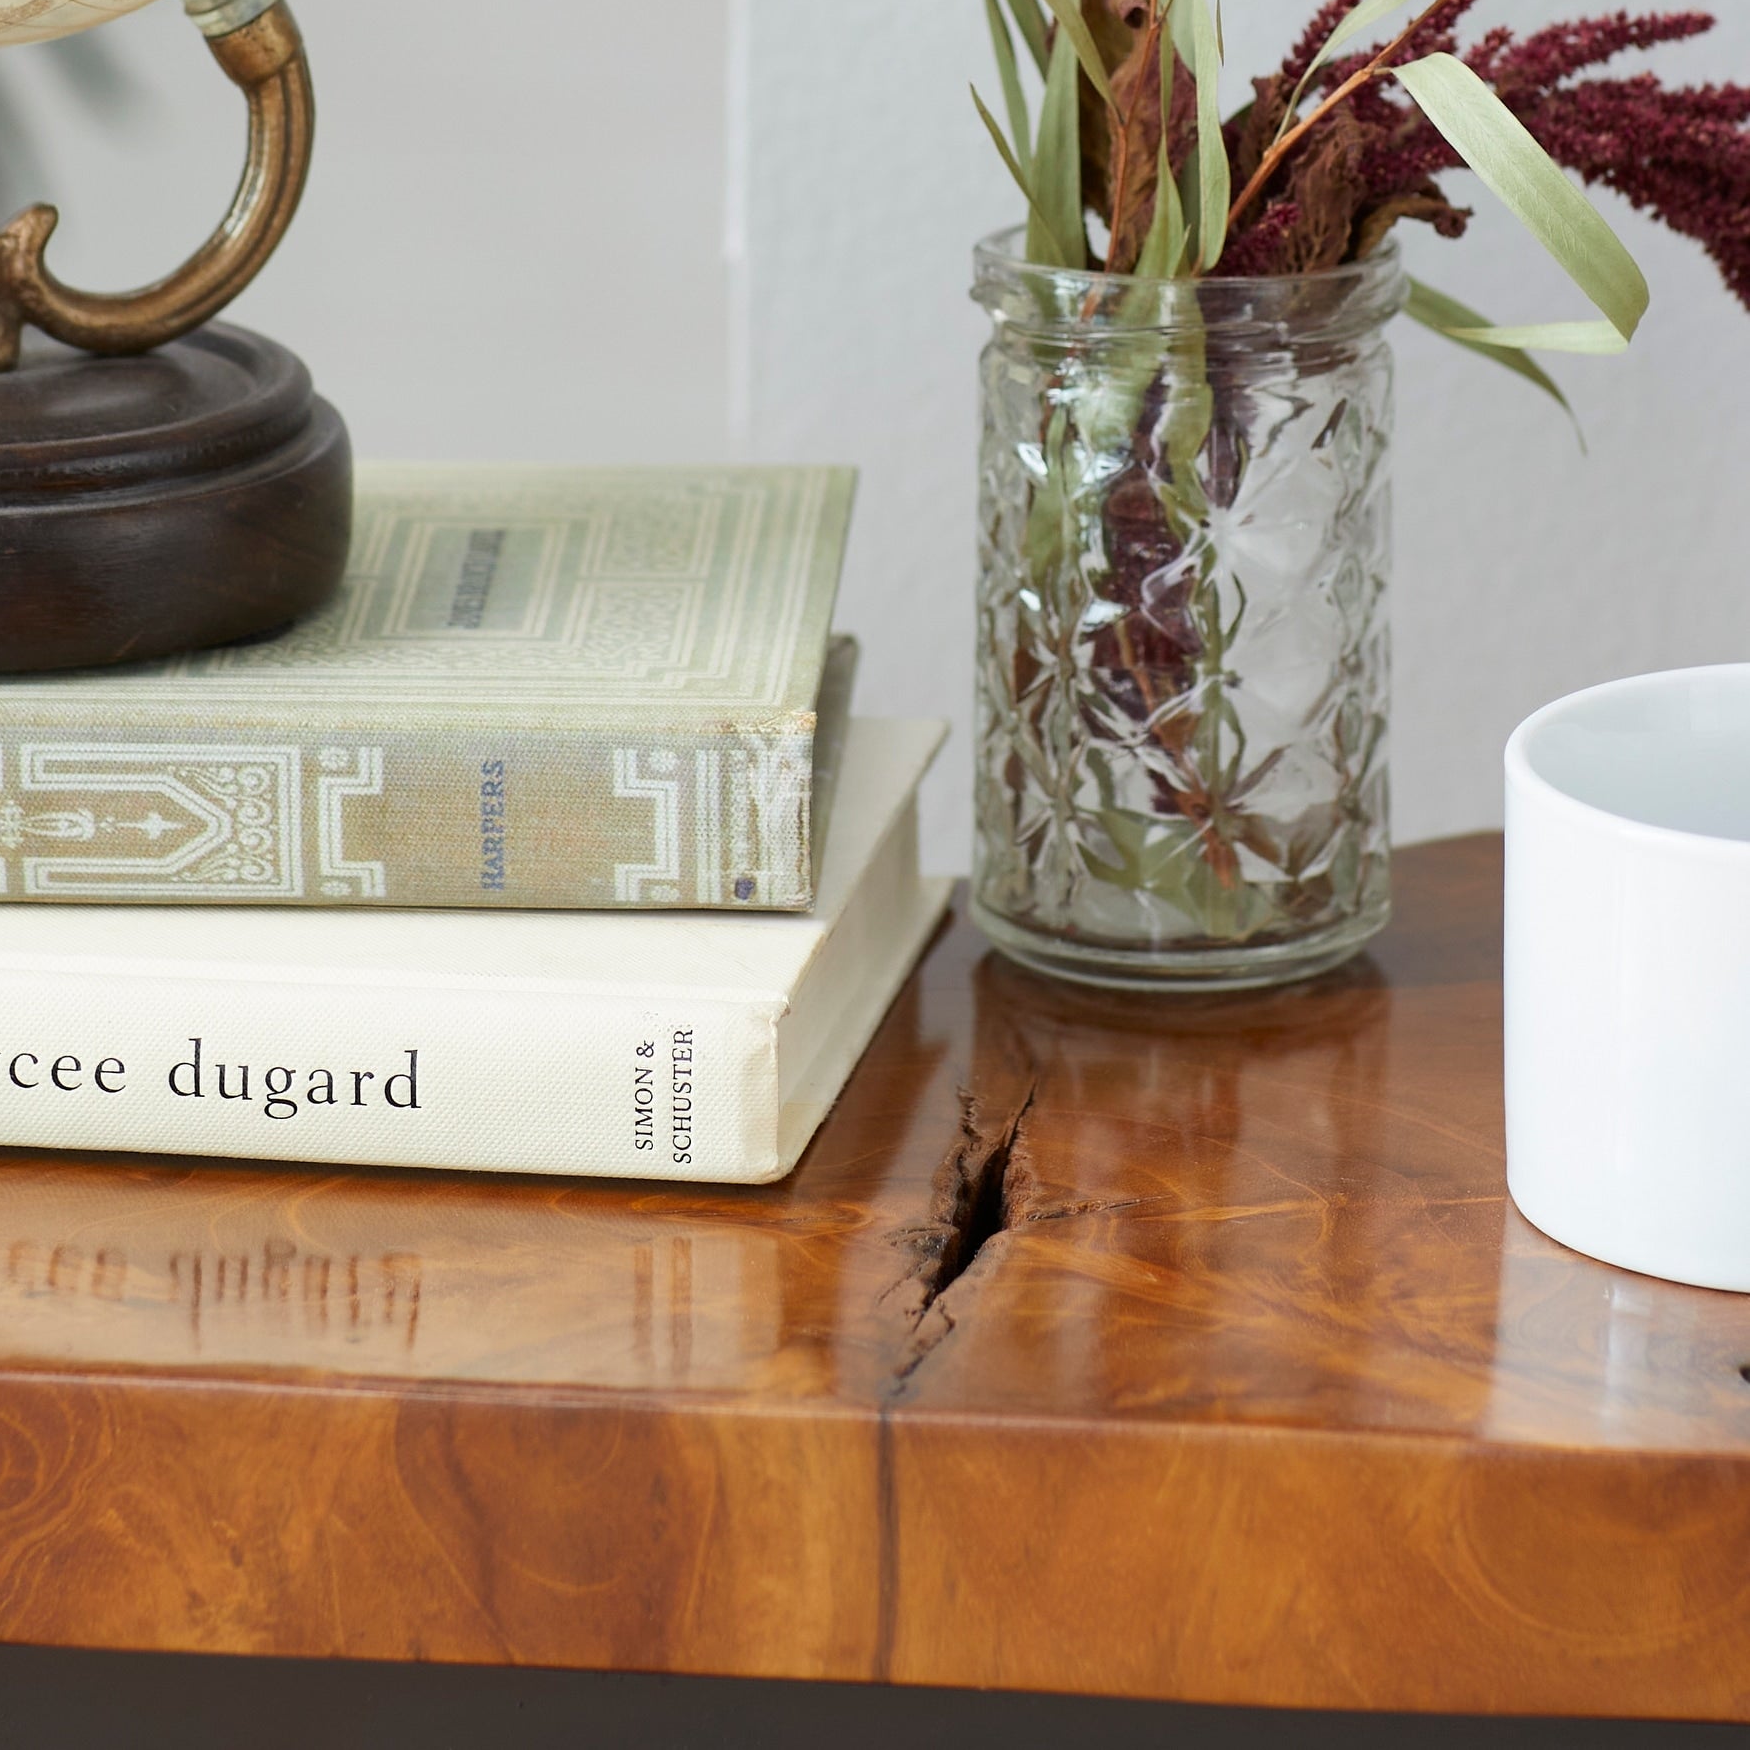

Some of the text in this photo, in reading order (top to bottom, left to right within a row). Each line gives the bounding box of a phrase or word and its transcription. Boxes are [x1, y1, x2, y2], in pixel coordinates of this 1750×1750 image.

[479, 758, 506, 893] HARPERS
[167, 1037, 423, 1120] dugard
[634, 1040, 655, 1152] SIMON &
[671, 1028, 694, 1165] SCHUSTER
